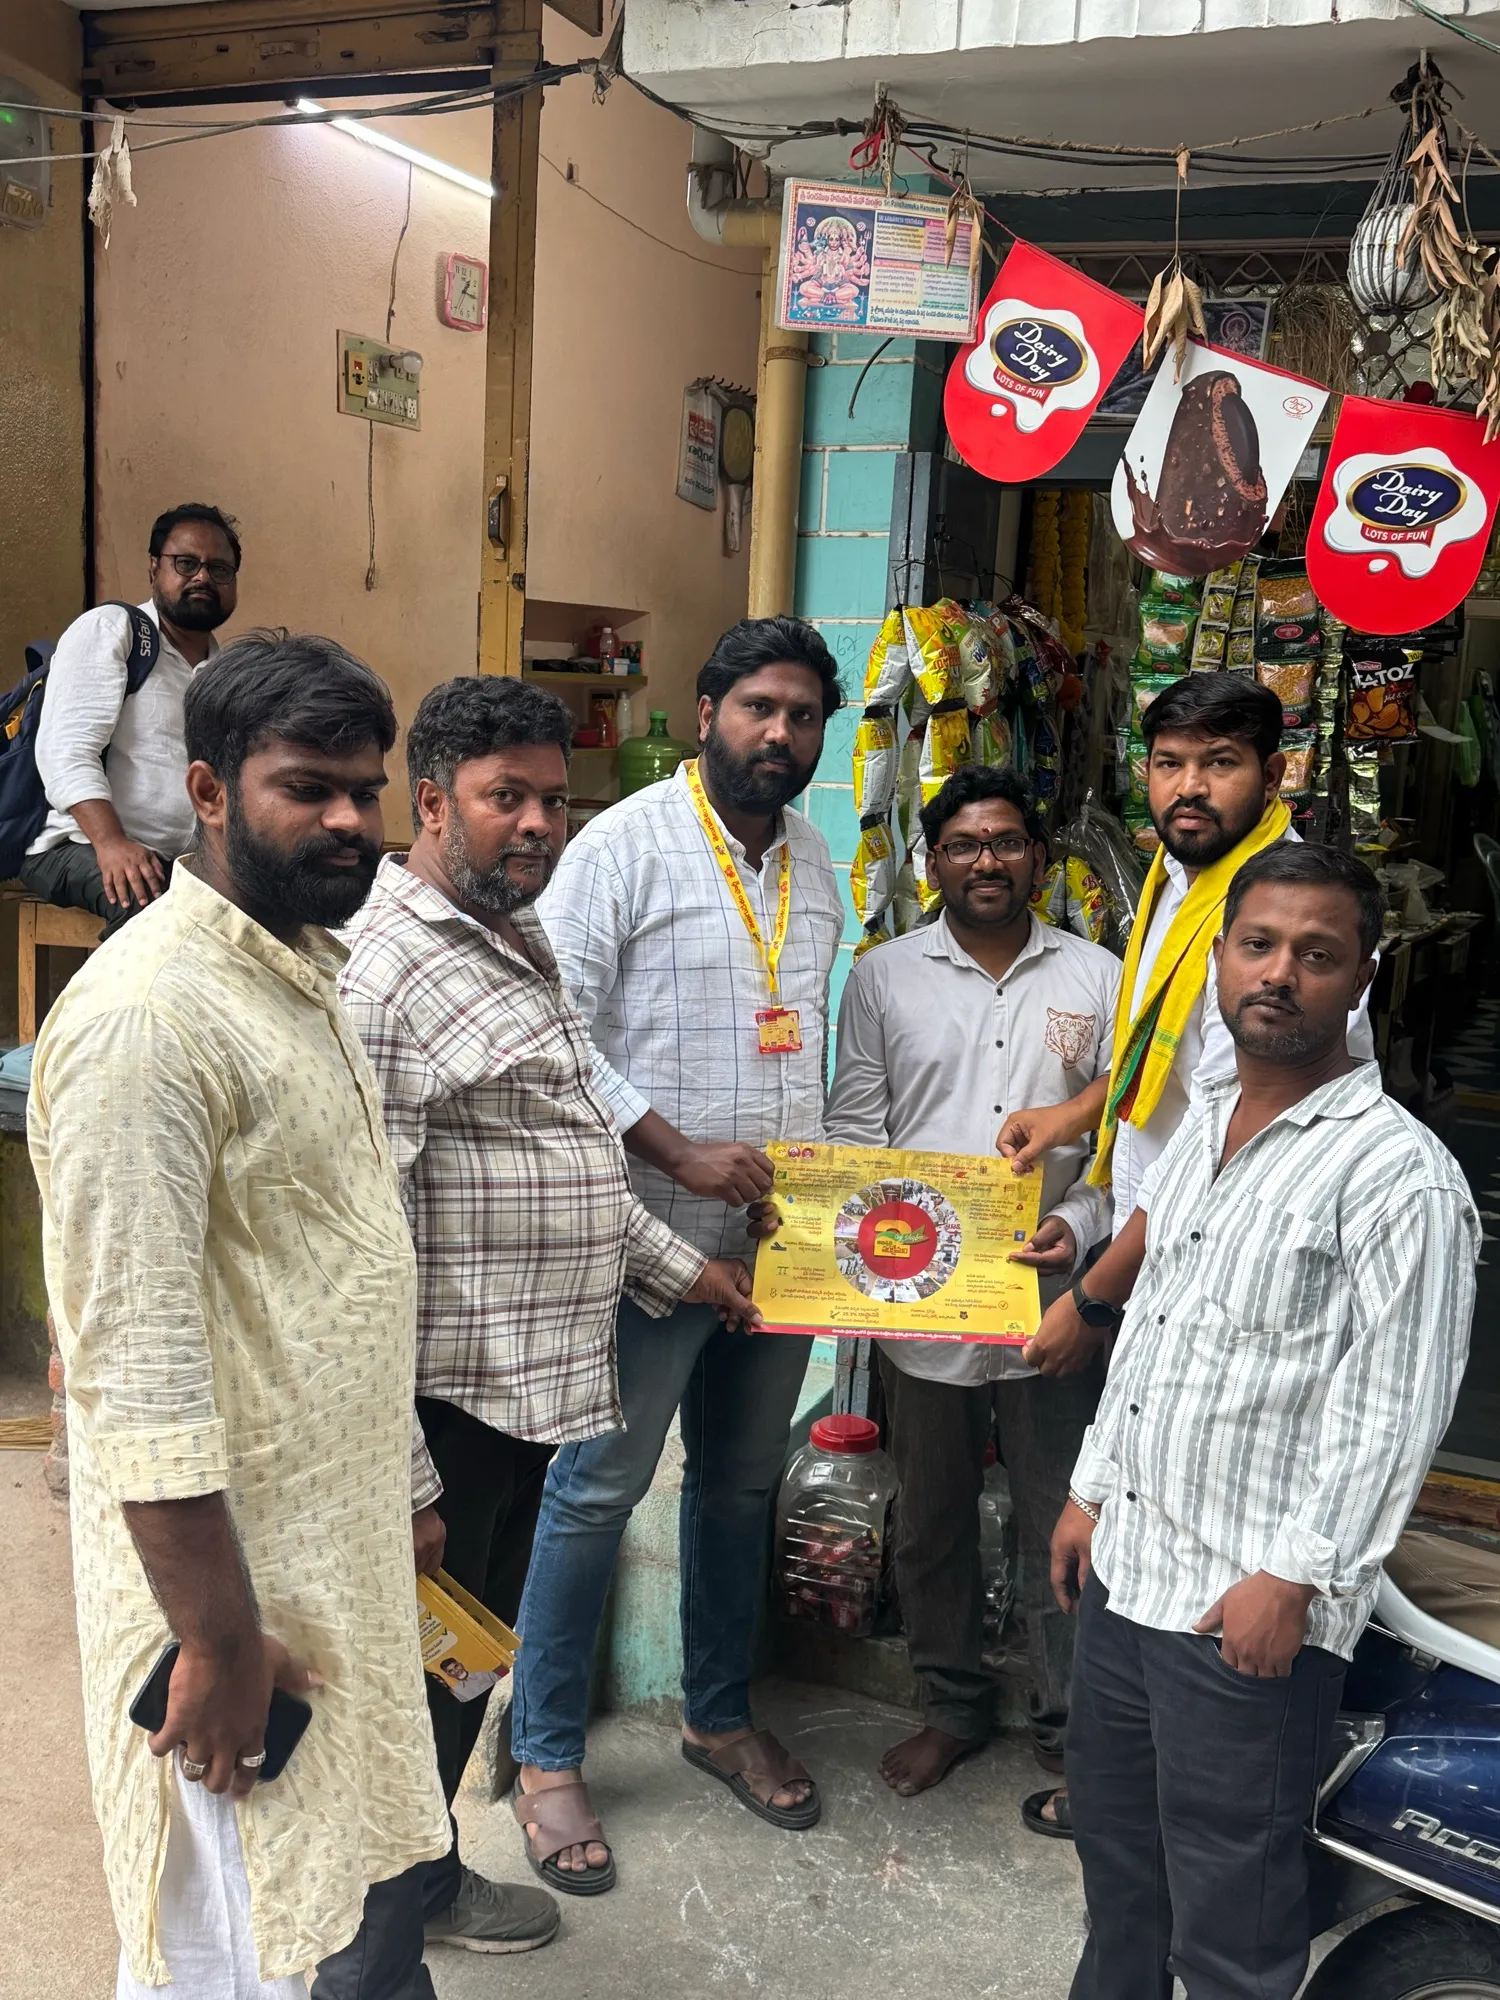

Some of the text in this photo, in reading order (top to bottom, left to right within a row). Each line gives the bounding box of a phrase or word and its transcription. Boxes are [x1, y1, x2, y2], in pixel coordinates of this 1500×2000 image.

[1010, 342, 1051, 382] Day
[1013, 320, 1068, 368] Dairy
[996, 371, 1045, 399] LOTS OF FUN
[1371, 469, 1444, 507] Dairy
[1374, 492, 1429, 527] Day
[1364, 527, 1429, 541] LOTS OF FUN
[136, 615, 152, 657] safari
[1352, 663, 1415, 689] TATOZ
